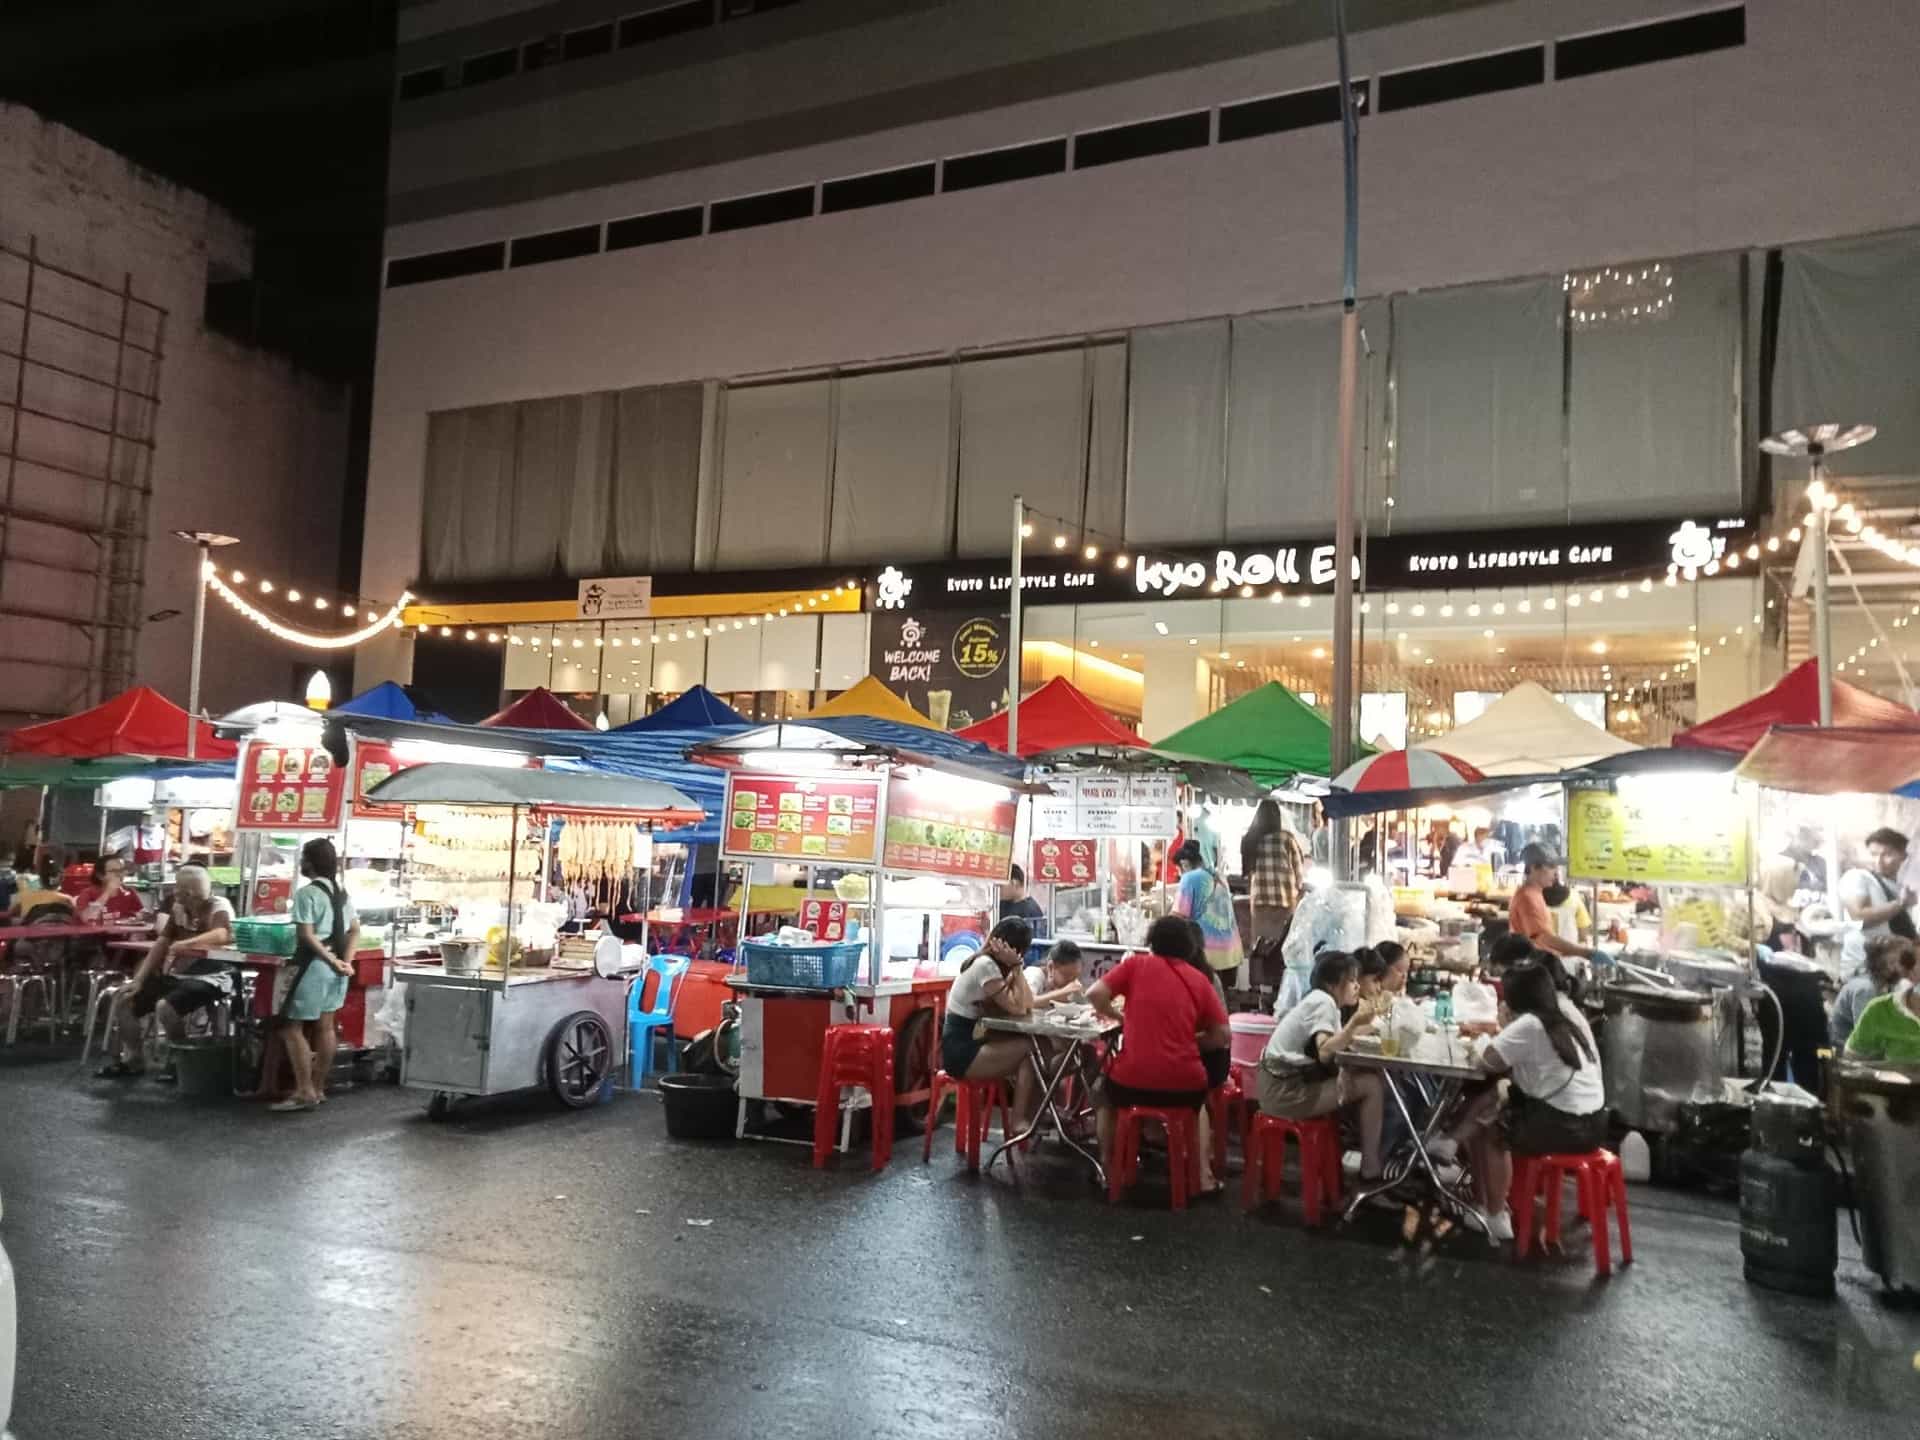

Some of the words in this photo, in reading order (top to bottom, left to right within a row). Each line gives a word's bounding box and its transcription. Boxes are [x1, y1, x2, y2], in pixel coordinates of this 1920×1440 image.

[1409, 555, 1458, 571] KYOTO
[1468, 550, 1560, 569] LIFESTYLE
[1568, 545, 1613, 564] CAFE
[946, 578, 984, 592] KYOTO
[1063, 572, 1096, 587] CAFE
[884, 648, 941, 665] WELCOME
[960, 643, 999, 663] 15%
[889, 664, 932, 682] BACK!
